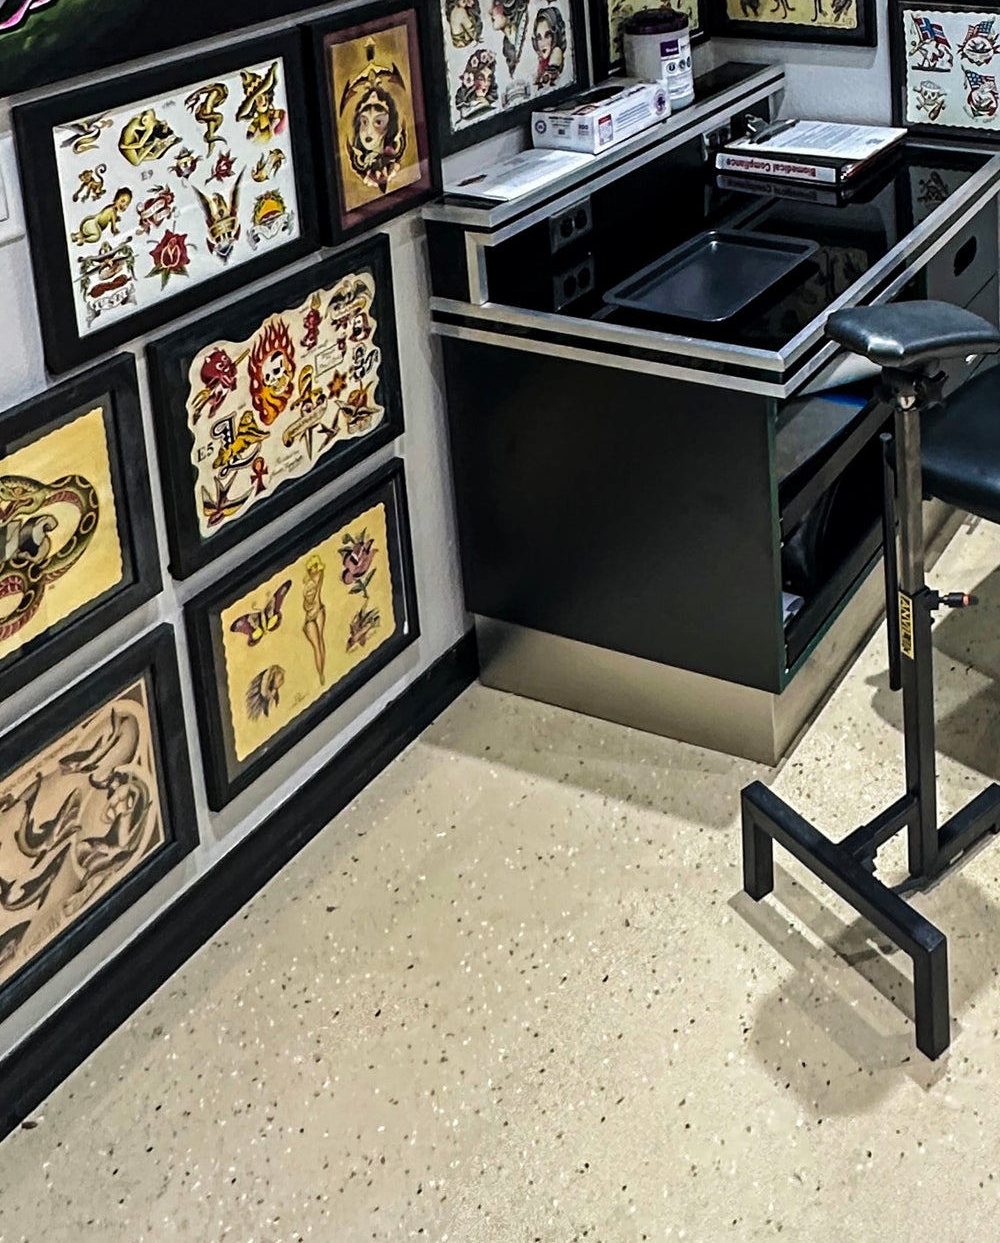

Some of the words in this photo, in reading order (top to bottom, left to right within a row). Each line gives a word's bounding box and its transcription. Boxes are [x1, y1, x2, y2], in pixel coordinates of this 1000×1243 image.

[726, 157, 770, 172] Compliance
[773, 163, 817, 178] Biomedical
[140, 169, 154, 181] E9
[196, 441, 215, 463] E5
